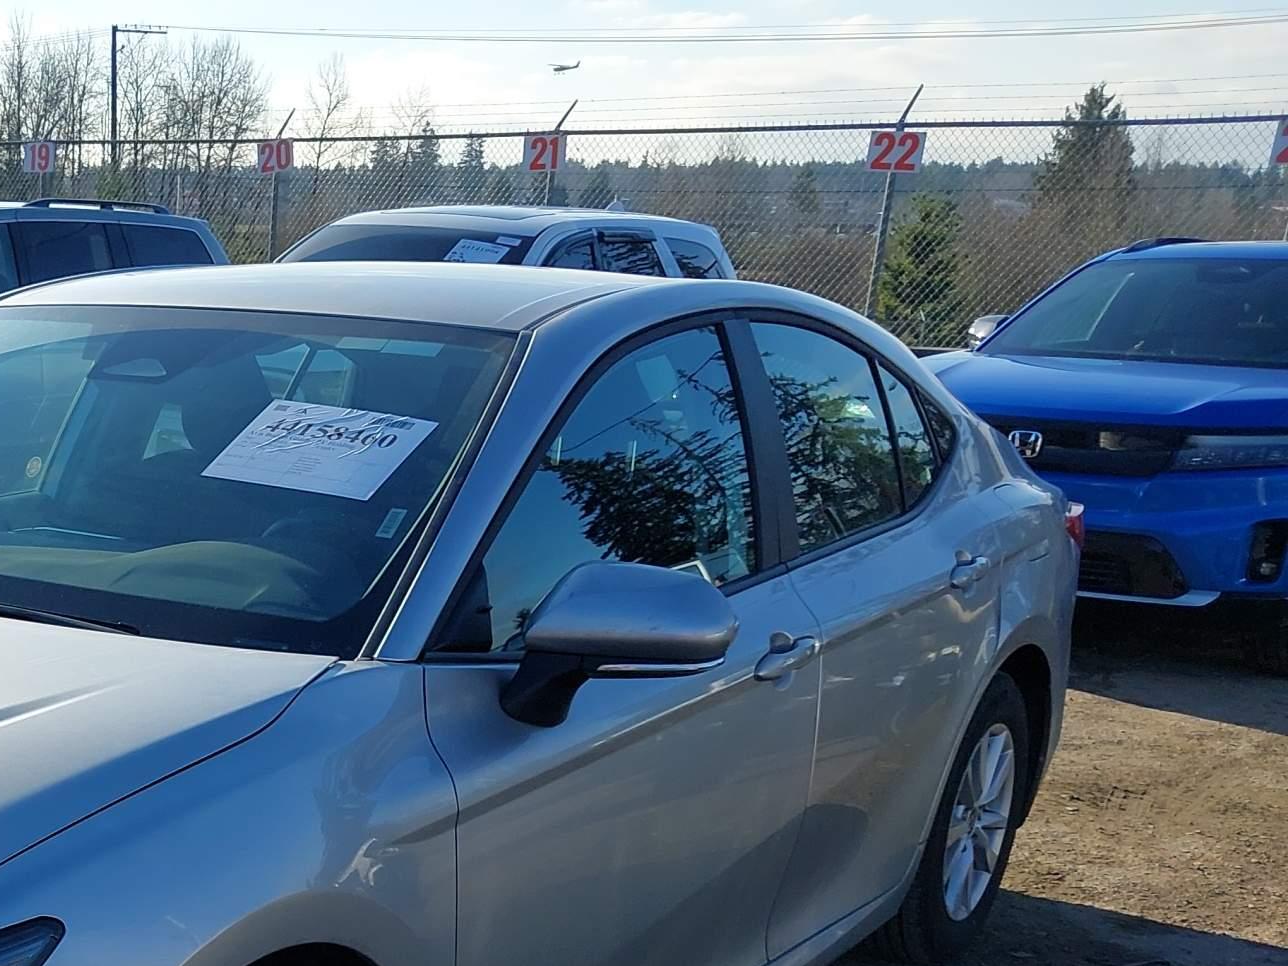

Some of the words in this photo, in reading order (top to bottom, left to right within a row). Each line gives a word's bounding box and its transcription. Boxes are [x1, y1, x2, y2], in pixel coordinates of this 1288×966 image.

[30, 143, 50, 171] 19
[261, 140, 292, 173] 20
[528, 136, 560, 171] 21
[870, 131, 920, 170] 22
